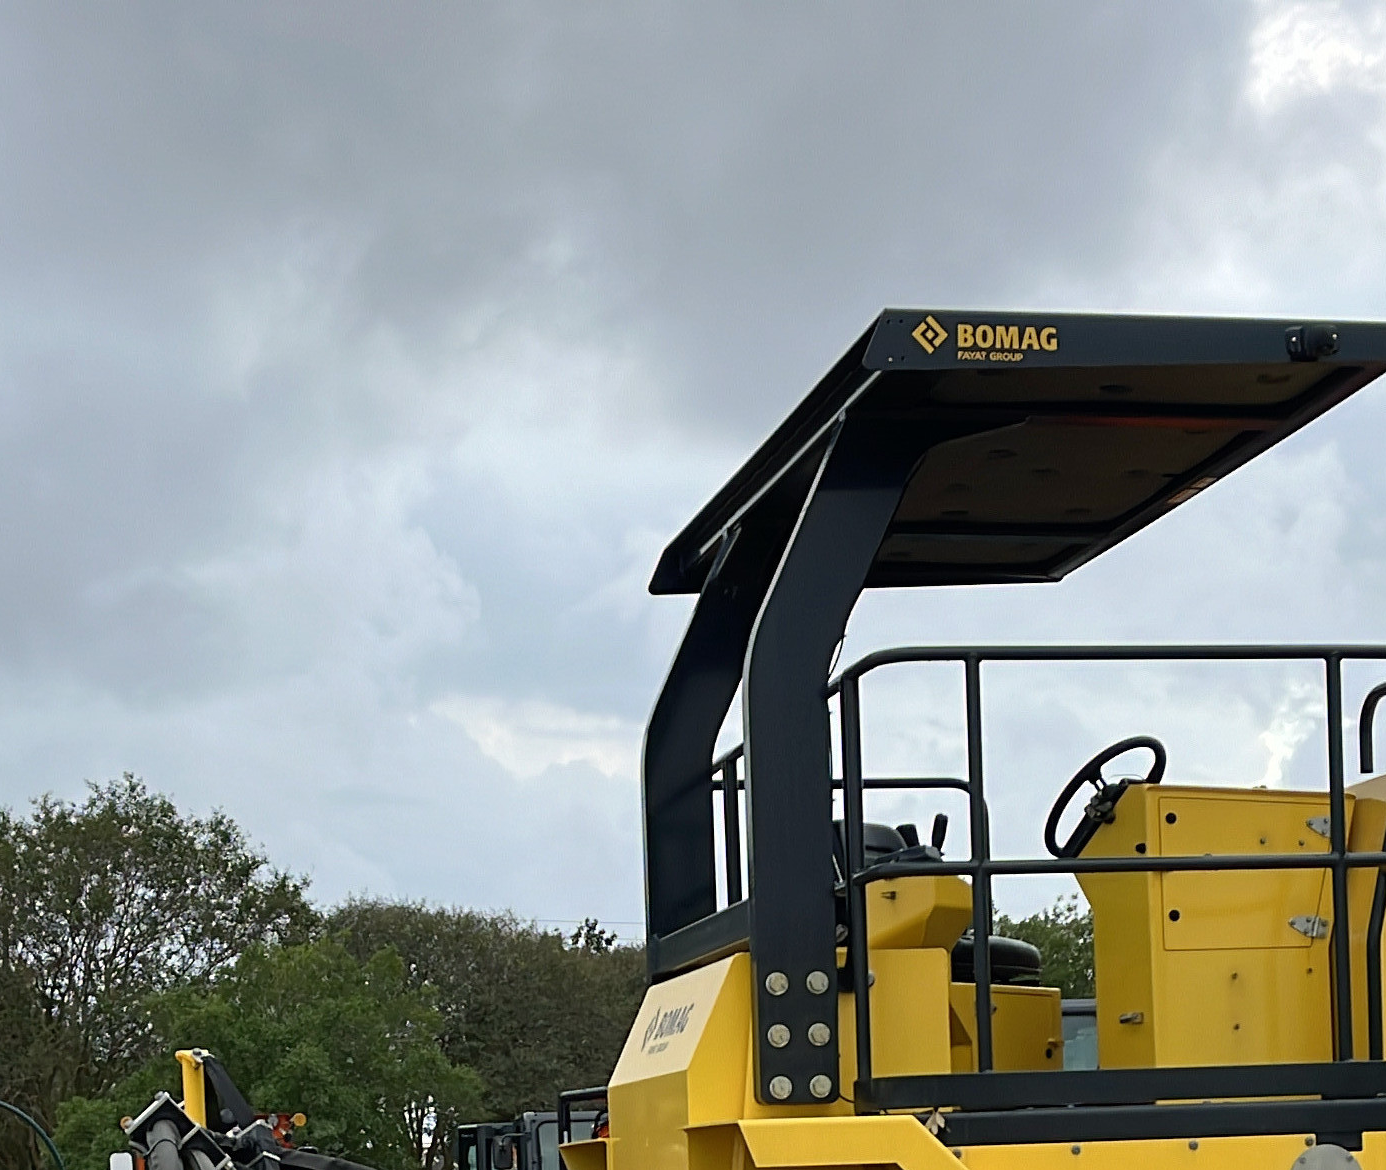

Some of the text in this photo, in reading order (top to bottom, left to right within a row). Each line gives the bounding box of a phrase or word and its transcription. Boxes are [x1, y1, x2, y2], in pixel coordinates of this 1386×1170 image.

[957, 323, 1058, 352] BOMAG
[957, 351, 1024, 362] FAYAT GROUP
[654, 1002, 695, 1041] BOMAG
